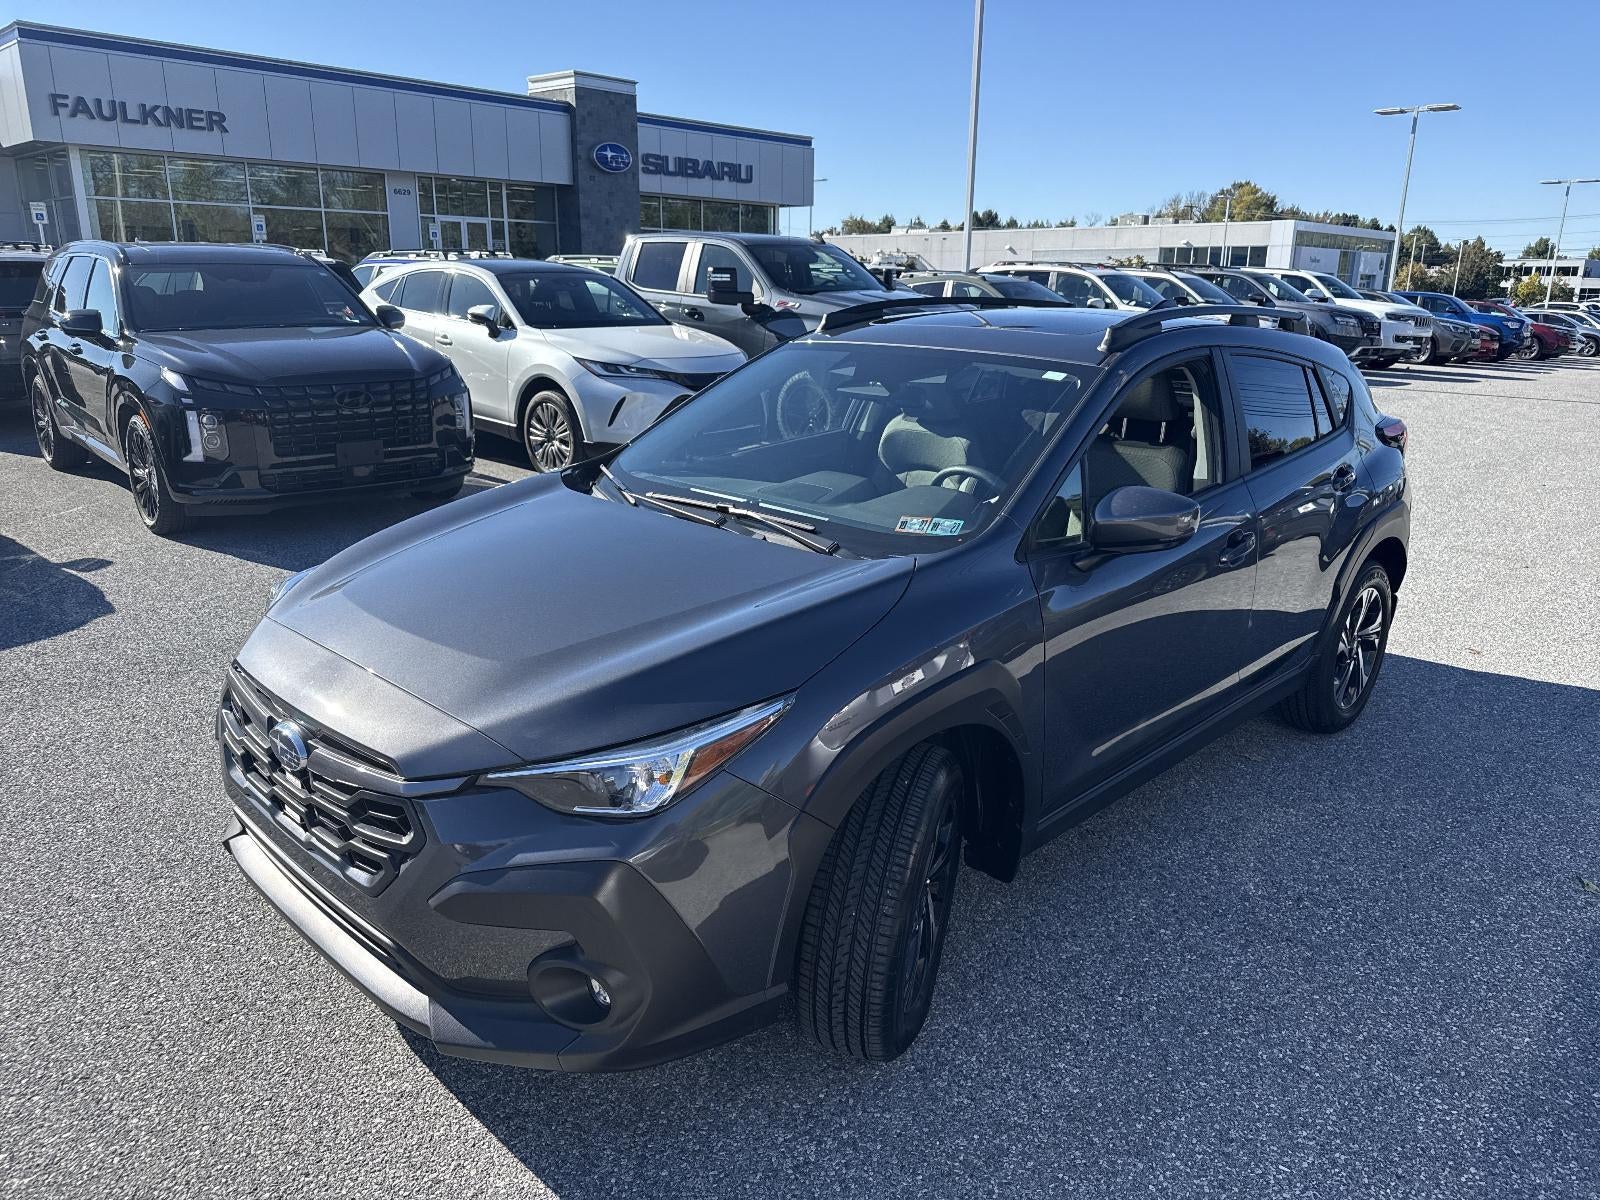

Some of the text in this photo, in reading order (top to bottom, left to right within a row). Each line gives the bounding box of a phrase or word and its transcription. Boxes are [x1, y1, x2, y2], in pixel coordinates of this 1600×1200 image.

[49, 93, 229, 133] FAULKNER
[641, 153, 753, 184] SUBARU
[393, 188, 411, 196] 6629
